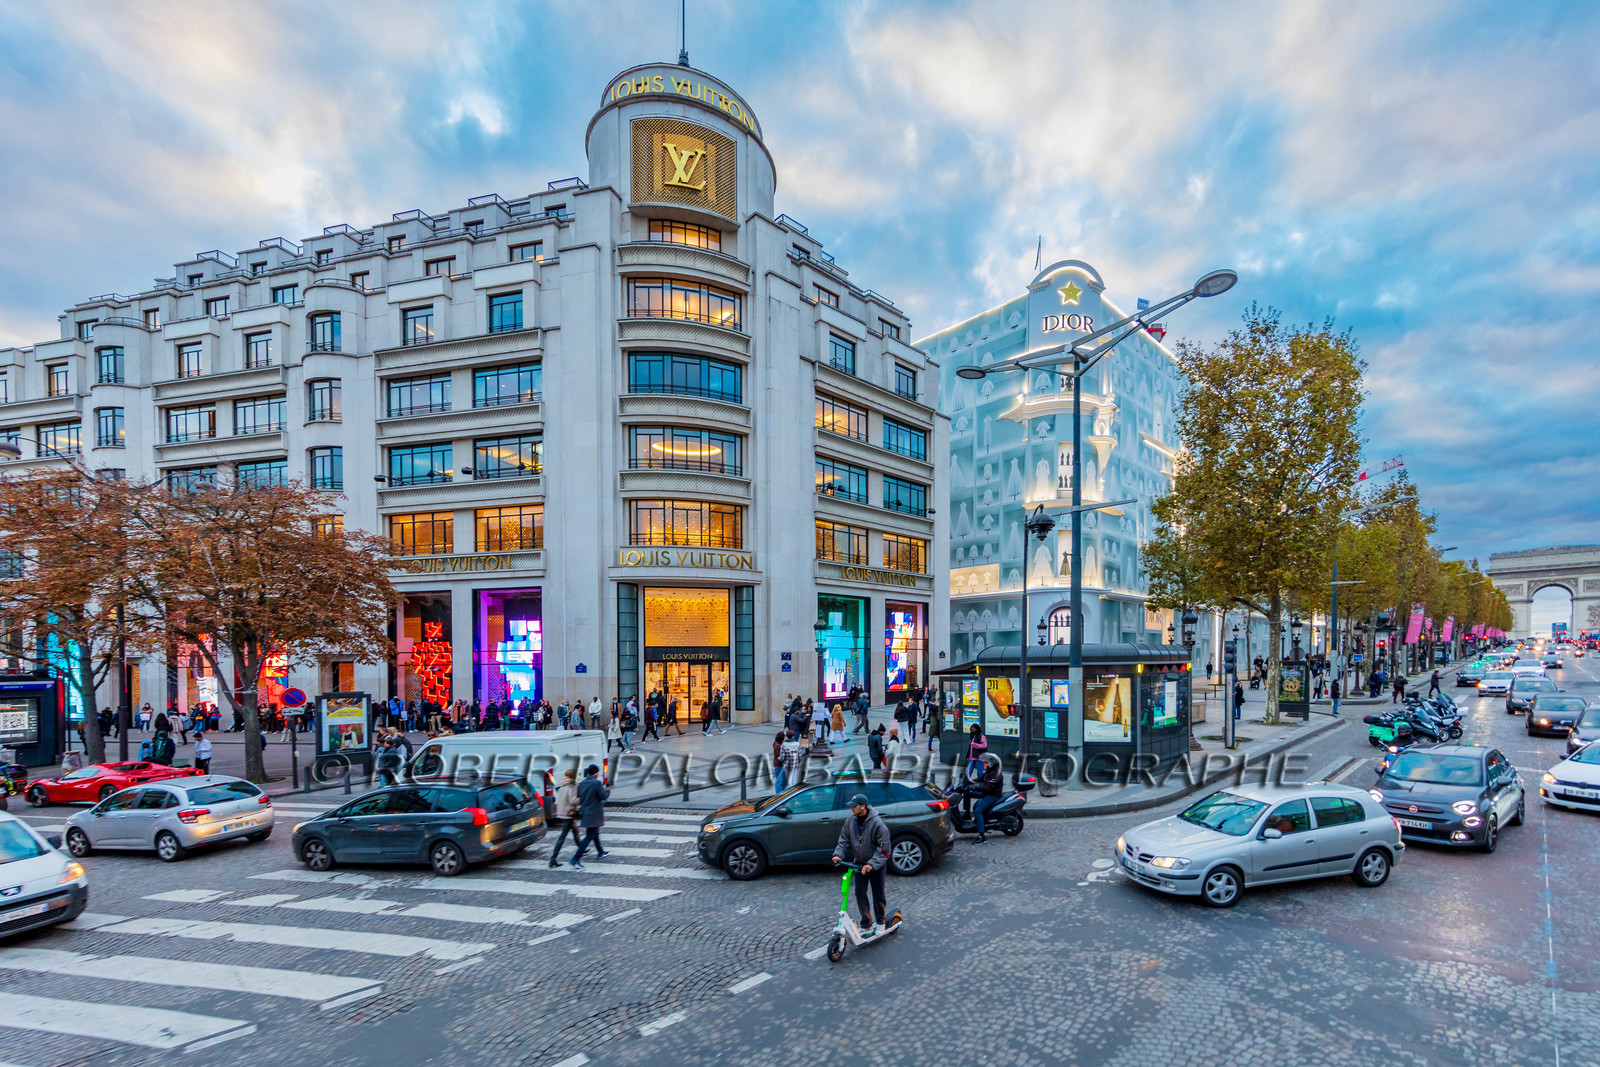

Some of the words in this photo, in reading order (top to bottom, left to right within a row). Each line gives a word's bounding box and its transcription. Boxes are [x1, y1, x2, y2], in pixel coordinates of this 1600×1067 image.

[611, 75, 664, 102] LOUIS
[671, 76, 754, 131] VUITTON
[1042, 313, 1094, 333] DIOR
[411, 558, 445, 574] OUIS
[447, 555, 512, 572] VUITTON
[620, 550, 671, 566] LOUIS
[676, 551, 753, 570] VUITTON
[841, 566, 872, 582] LOUIS
[874, 570, 917, 587] VUITTON
[498, 683, 522, 691] LOUIS
